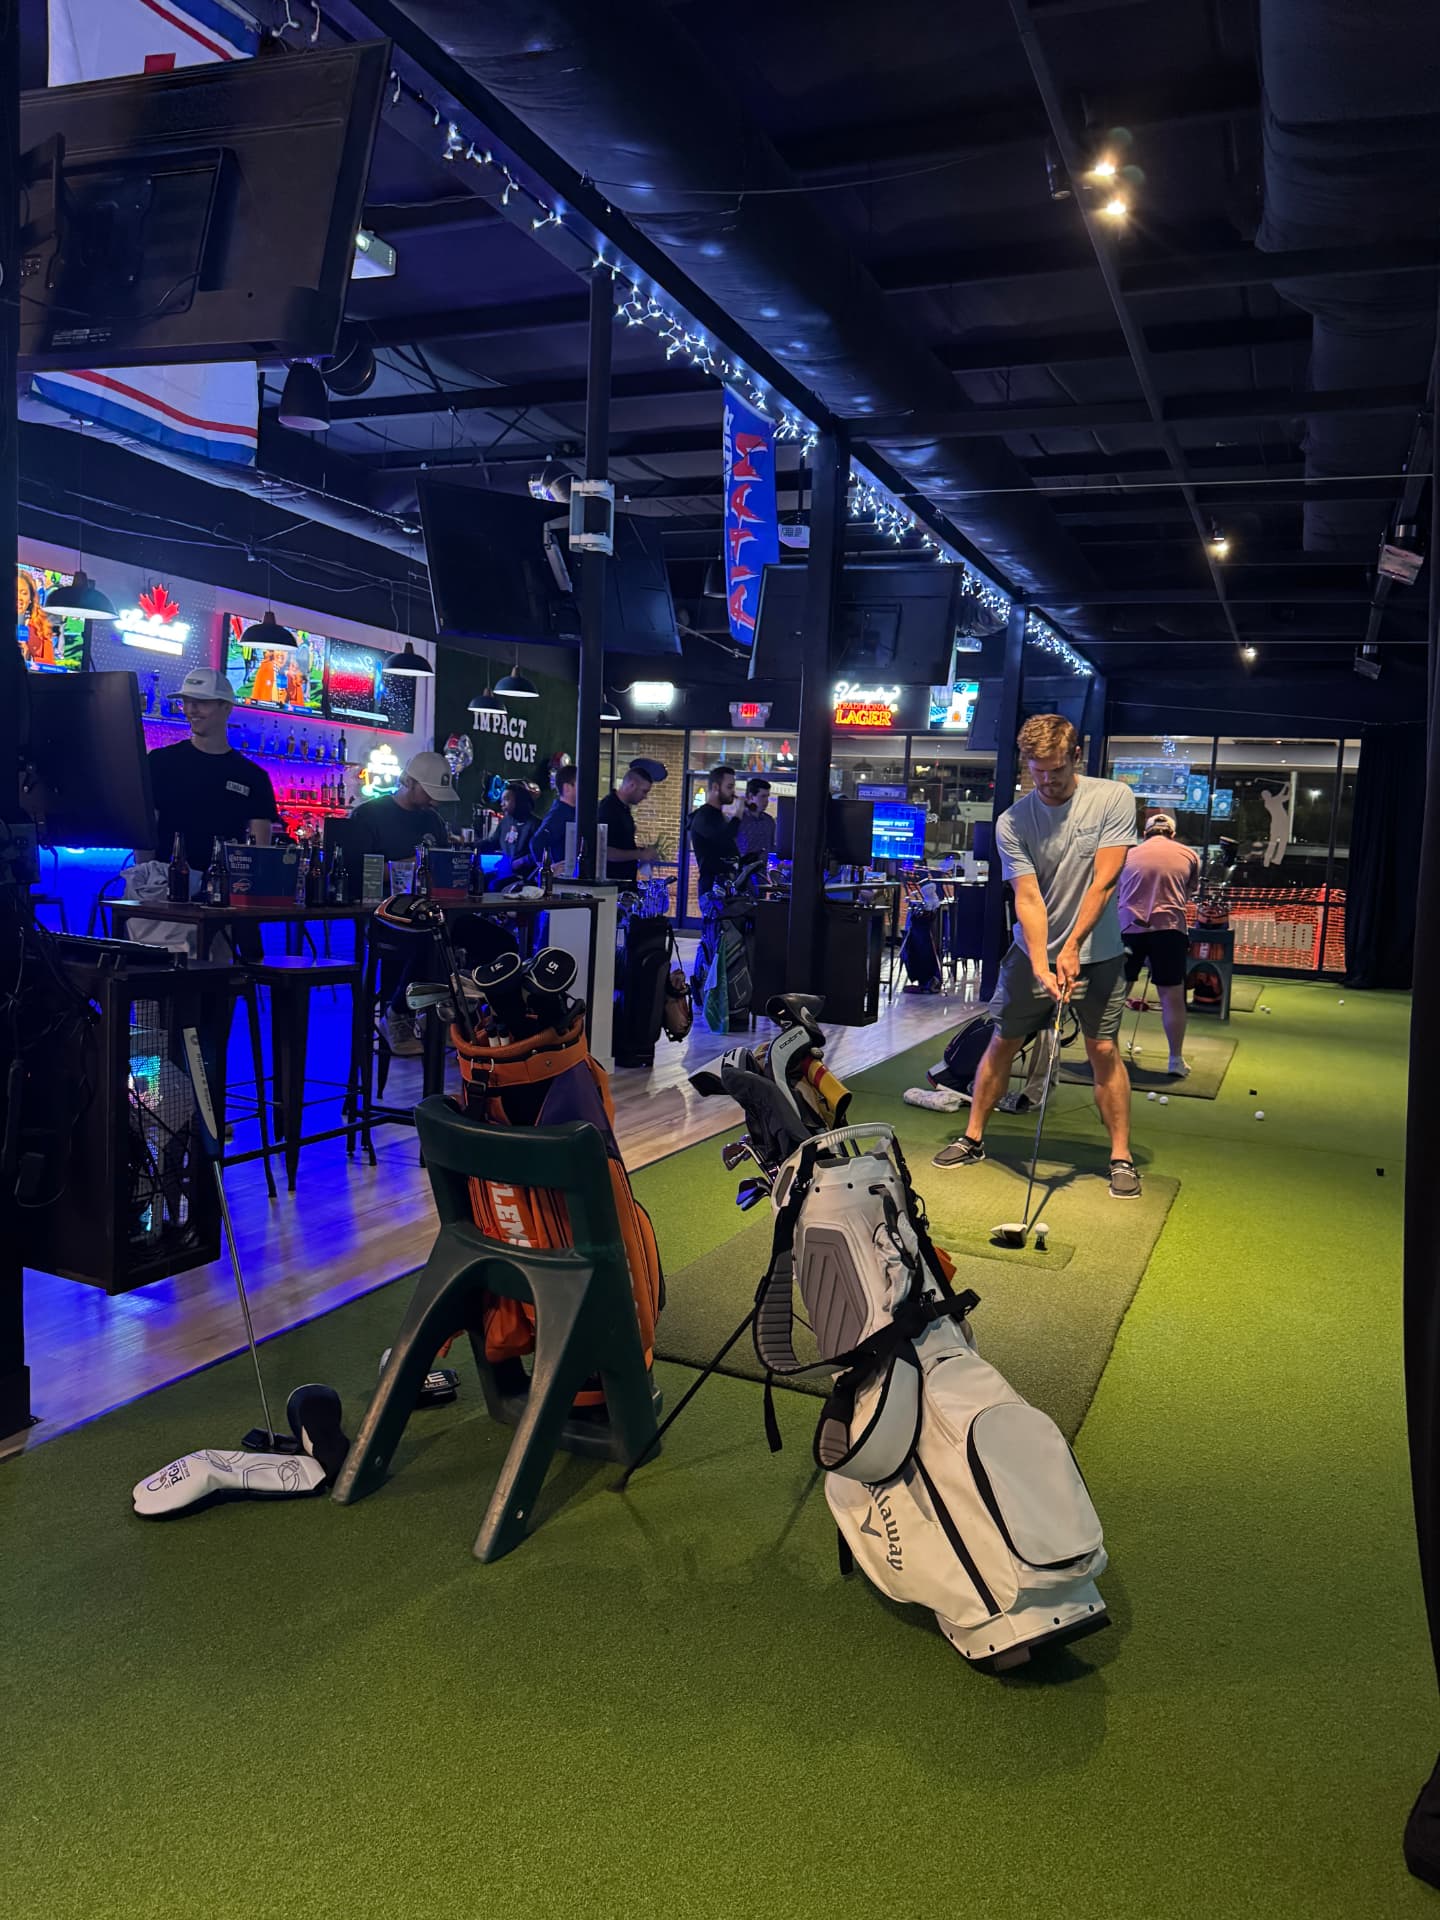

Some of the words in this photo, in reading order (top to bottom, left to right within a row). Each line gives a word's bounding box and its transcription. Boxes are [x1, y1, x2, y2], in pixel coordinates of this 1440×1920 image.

[835, 709, 892, 726] LAGER
[837, 702, 890, 711] TRADITIONAL
[473, 711, 527, 739] IMPACT
[504, 741, 537, 763] GOLF
[491, 1182, 532, 1248] LEM
[167, 1462, 182, 1486] PGA
[861, 1483, 904, 1571] allaway
